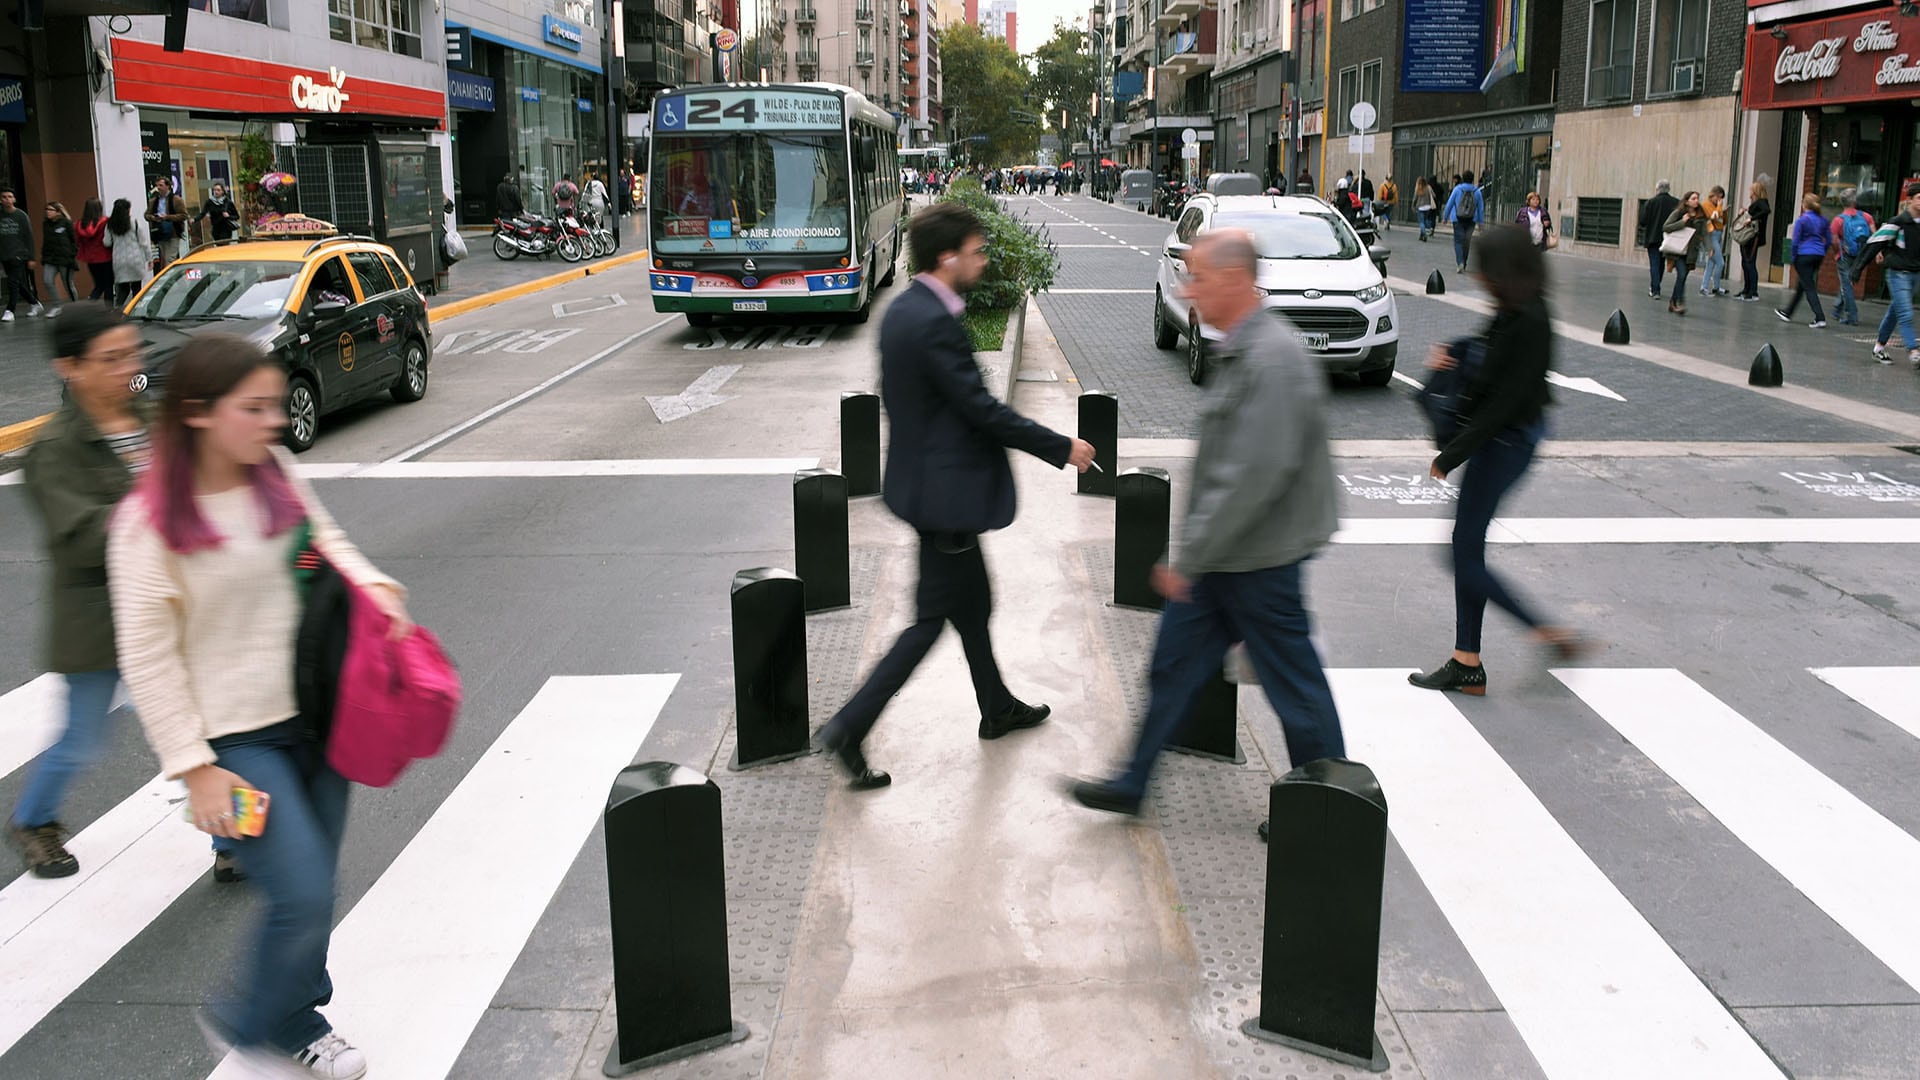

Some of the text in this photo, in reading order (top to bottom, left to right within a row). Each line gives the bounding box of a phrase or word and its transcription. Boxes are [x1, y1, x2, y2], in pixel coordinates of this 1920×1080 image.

[0, 81, 23, 107] BROS
[291, 73, 344, 113] Claro
[763, 98, 841, 110] WILDE PLAZA DE MAYO
[687, 98, 760, 125] 24
[763, 112, 797, 124] TRIBUNALES
[807, 113, 819, 124] DEL
[819, 113, 841, 124] PARQUE
[750, 227, 841, 238] AIRE ACONDICIONADO
[1312, 336, 1327, 347] 731
